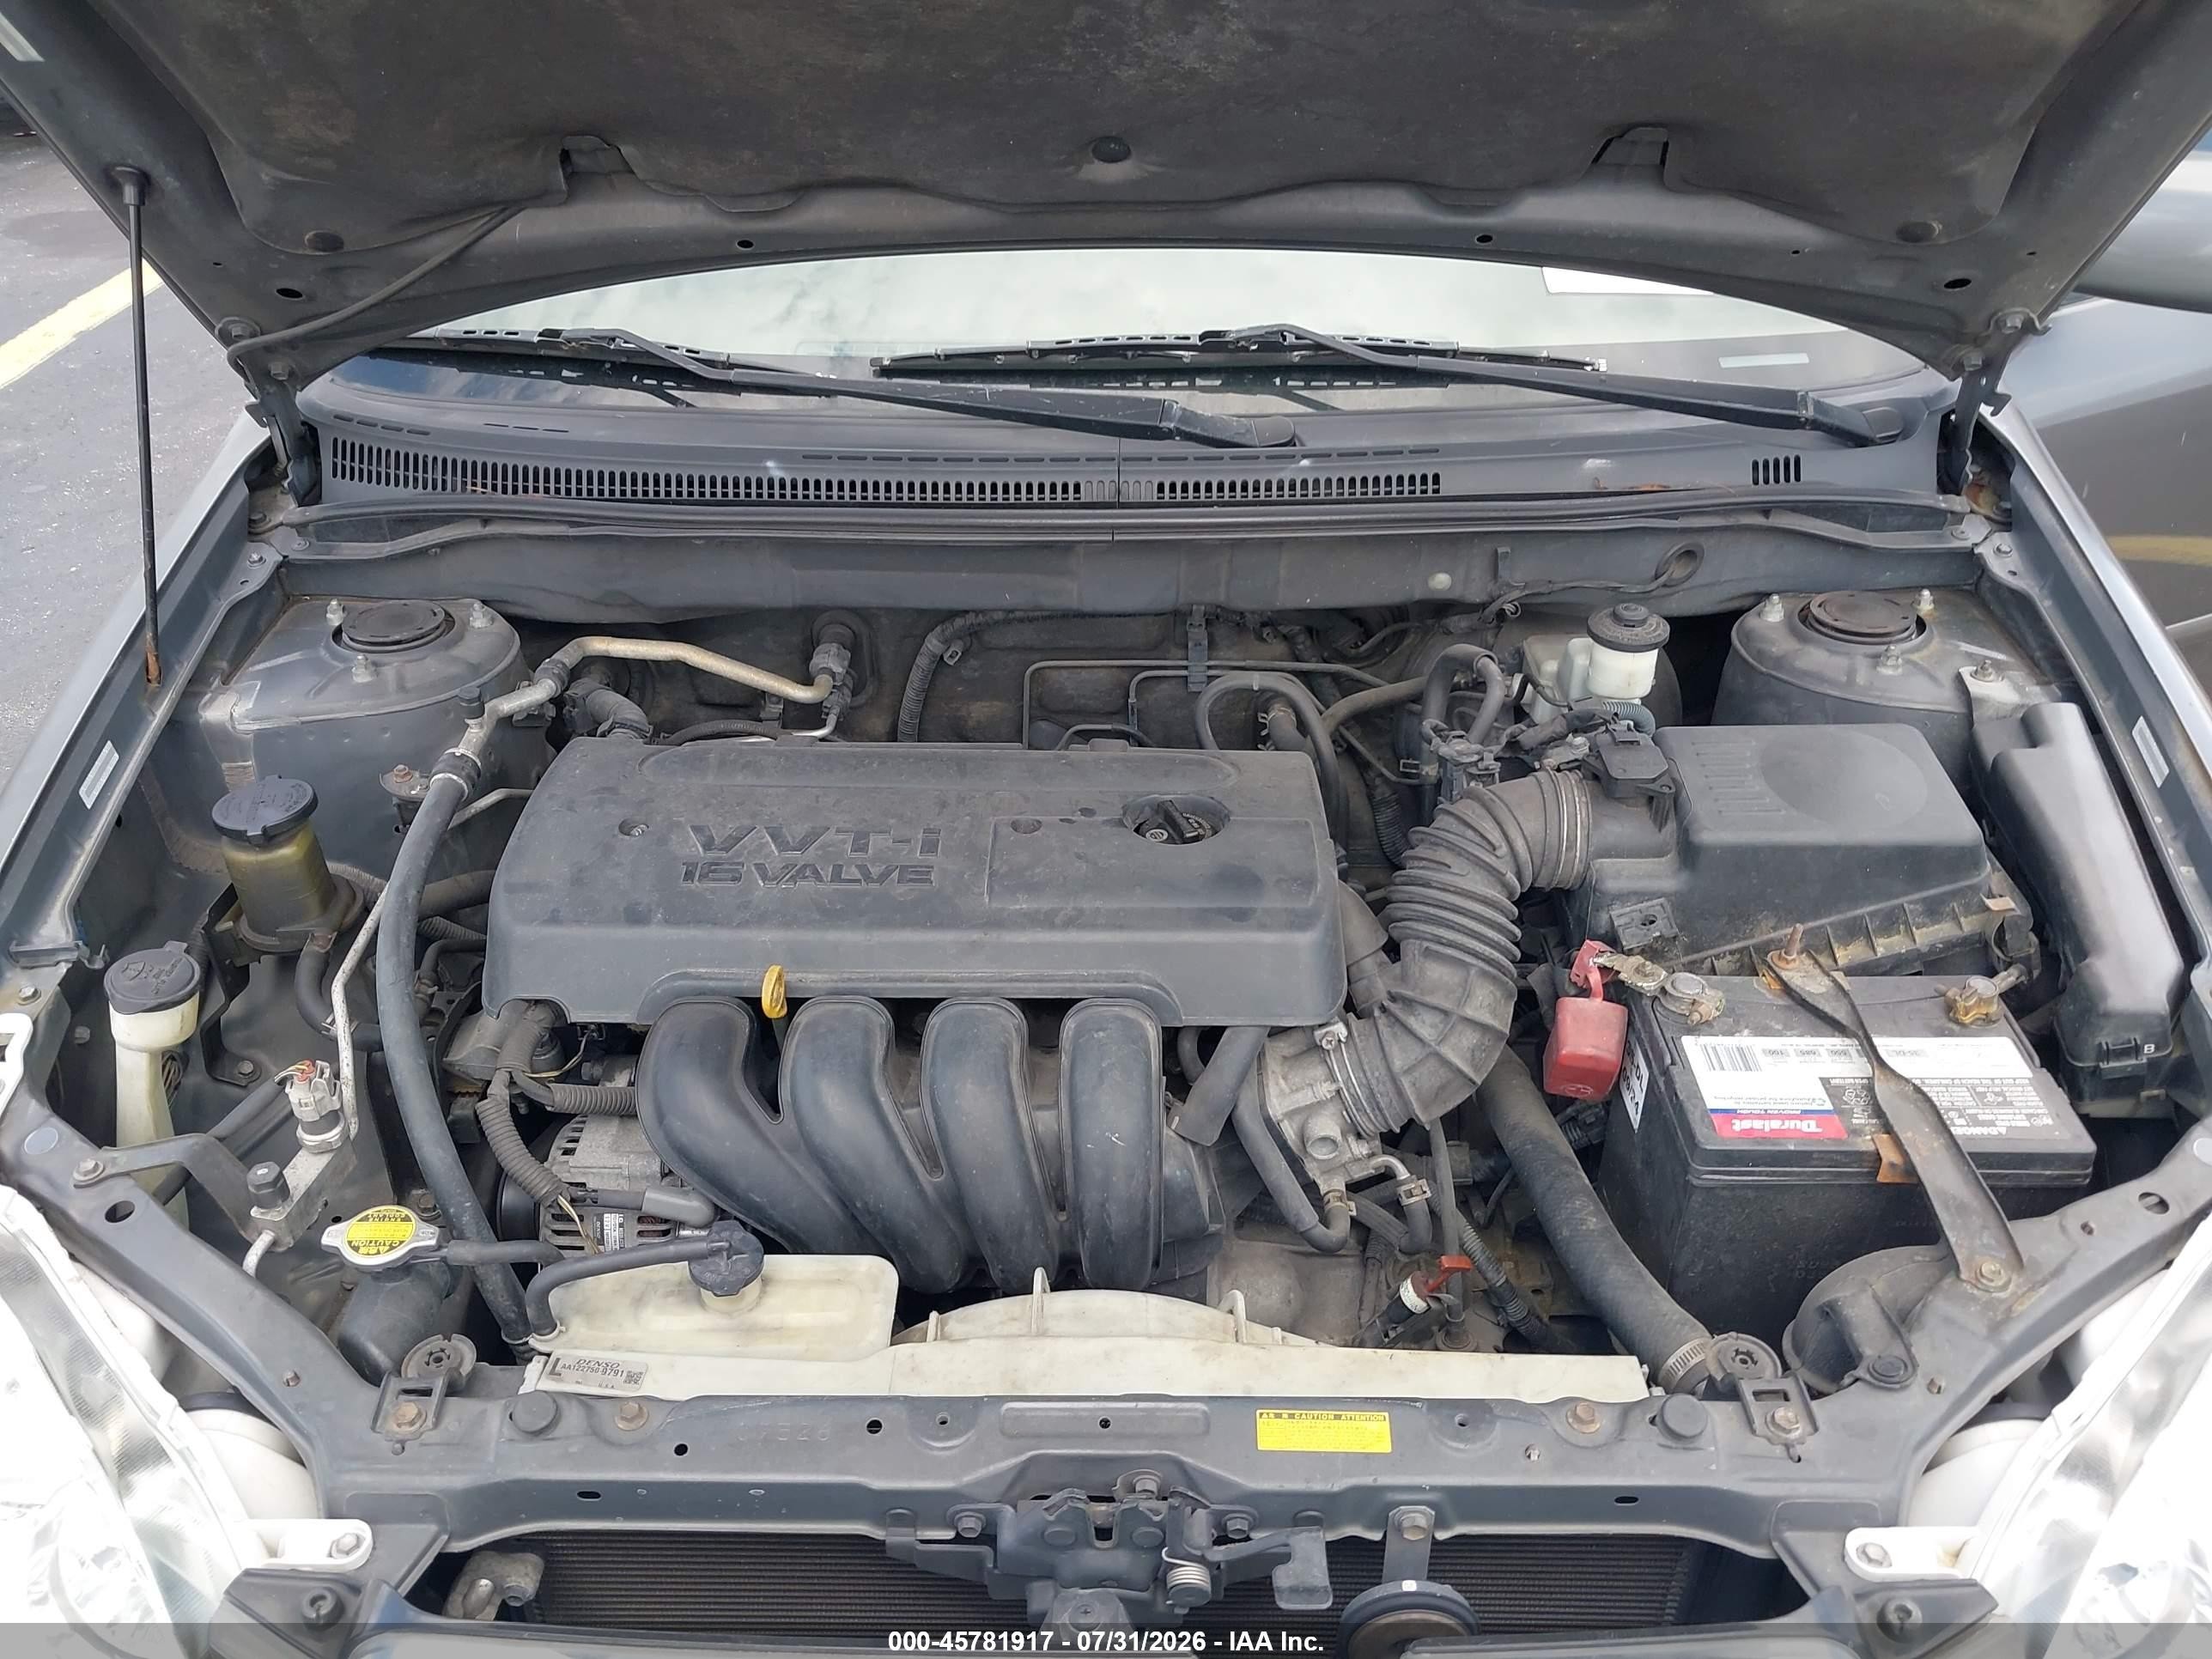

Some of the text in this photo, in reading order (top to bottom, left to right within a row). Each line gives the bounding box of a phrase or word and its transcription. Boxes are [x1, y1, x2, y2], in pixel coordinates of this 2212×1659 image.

[681, 861, 935, 888] 16 VALVE
[2143, 1043, 2155, 1054] B
[1731, 1119, 1823, 1133] Duralast
[550, 1358, 562, 1376] L
[576, 1358, 620, 1369] DENSO
